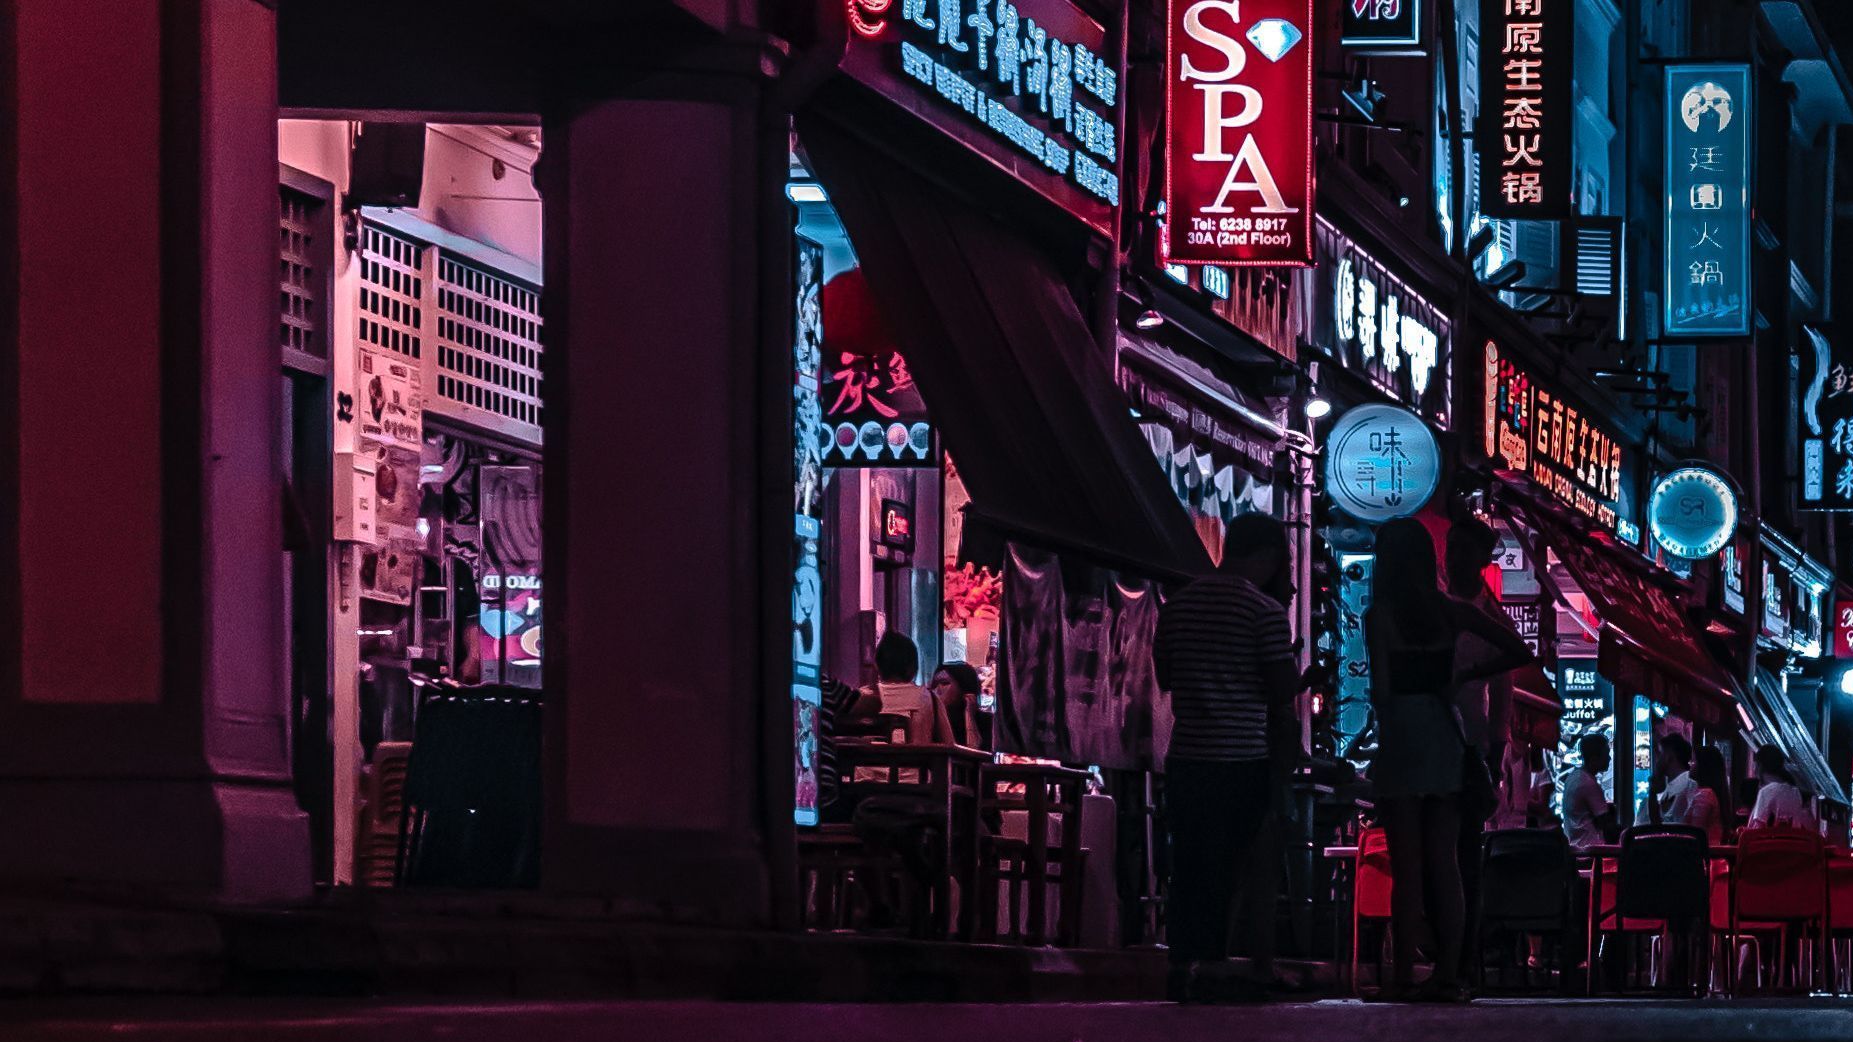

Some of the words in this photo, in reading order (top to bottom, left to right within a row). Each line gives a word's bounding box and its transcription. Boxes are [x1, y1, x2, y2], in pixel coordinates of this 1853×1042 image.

[1180, 0, 1299, 213] SPA
[1191, 217, 1216, 231] Tel:
[1219, 217, 1251, 231] 6238
[1255, 217, 1287, 231] 8917
[1187, 232, 1214, 246] 30A
[1217, 232, 1248, 247] (2nd
[1251, 232, 1291, 247] Floor)
